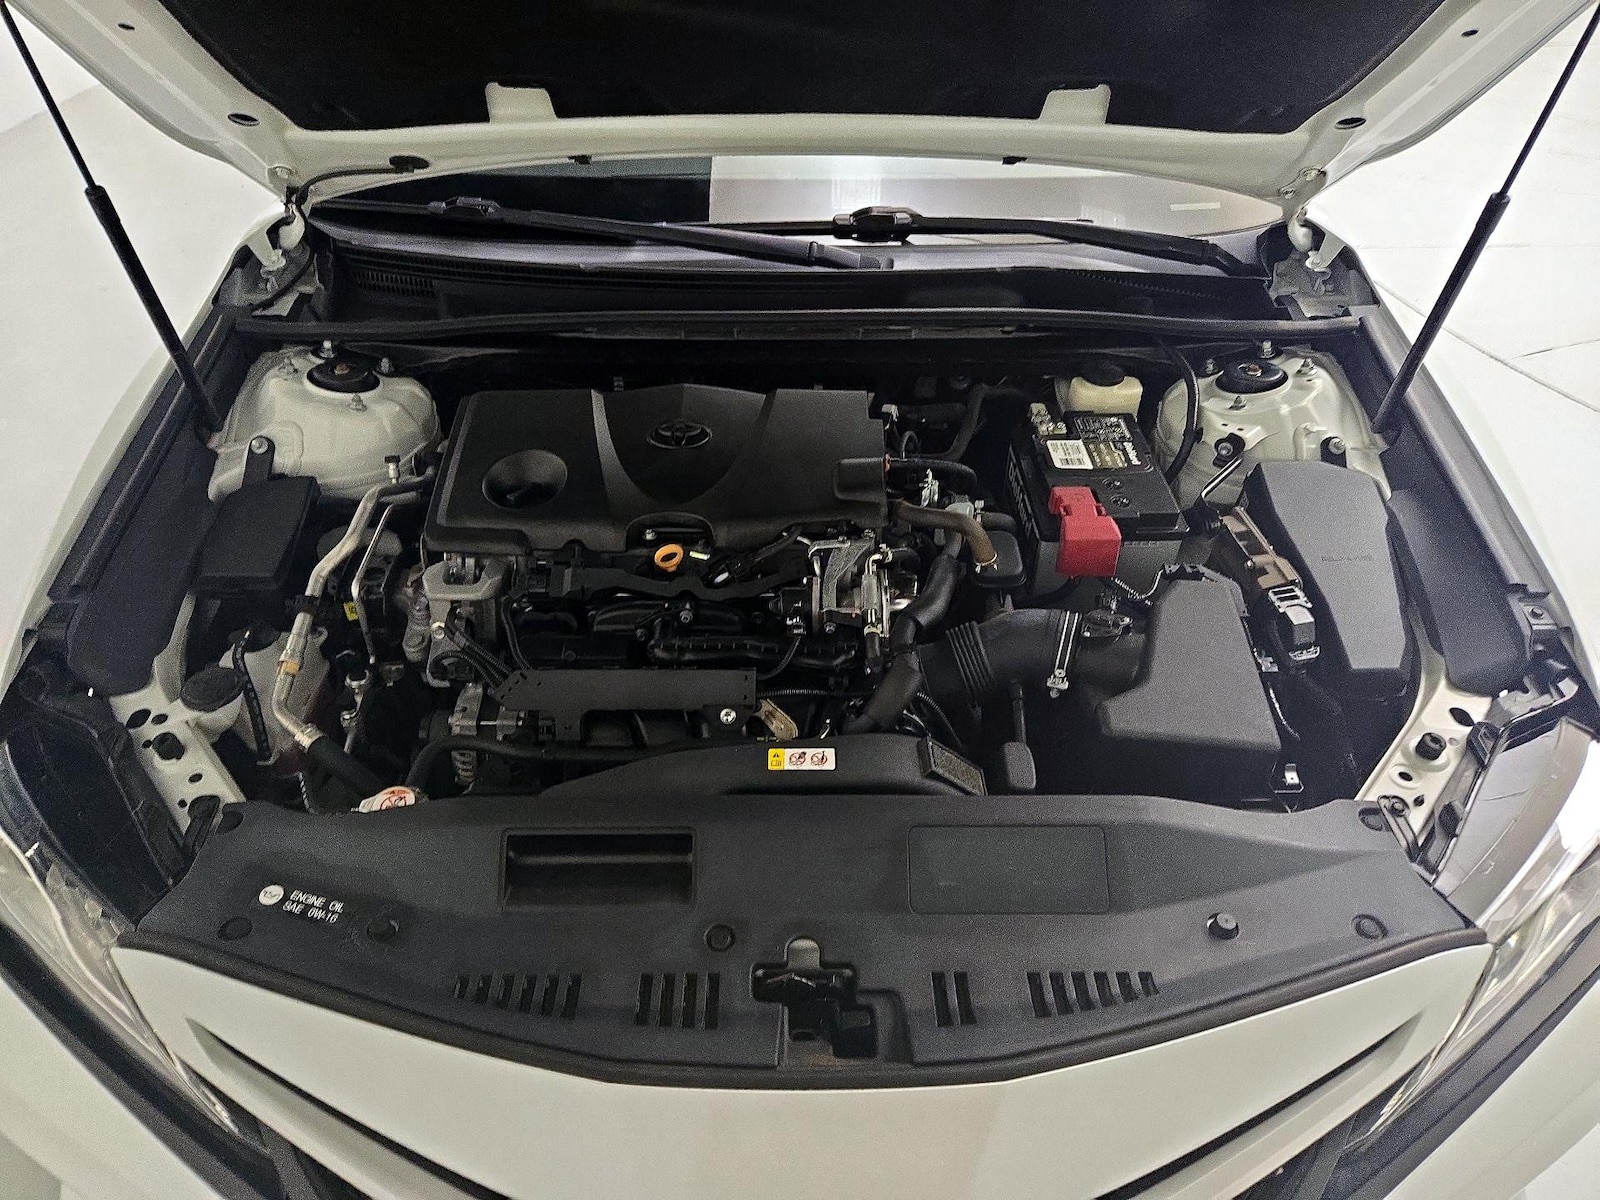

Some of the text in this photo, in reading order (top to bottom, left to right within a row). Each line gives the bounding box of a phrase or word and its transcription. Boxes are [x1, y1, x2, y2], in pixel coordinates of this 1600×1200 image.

[282, 900, 340, 924] SAE 0W-16
[289, 889, 345, 913] ENGINE OIL
